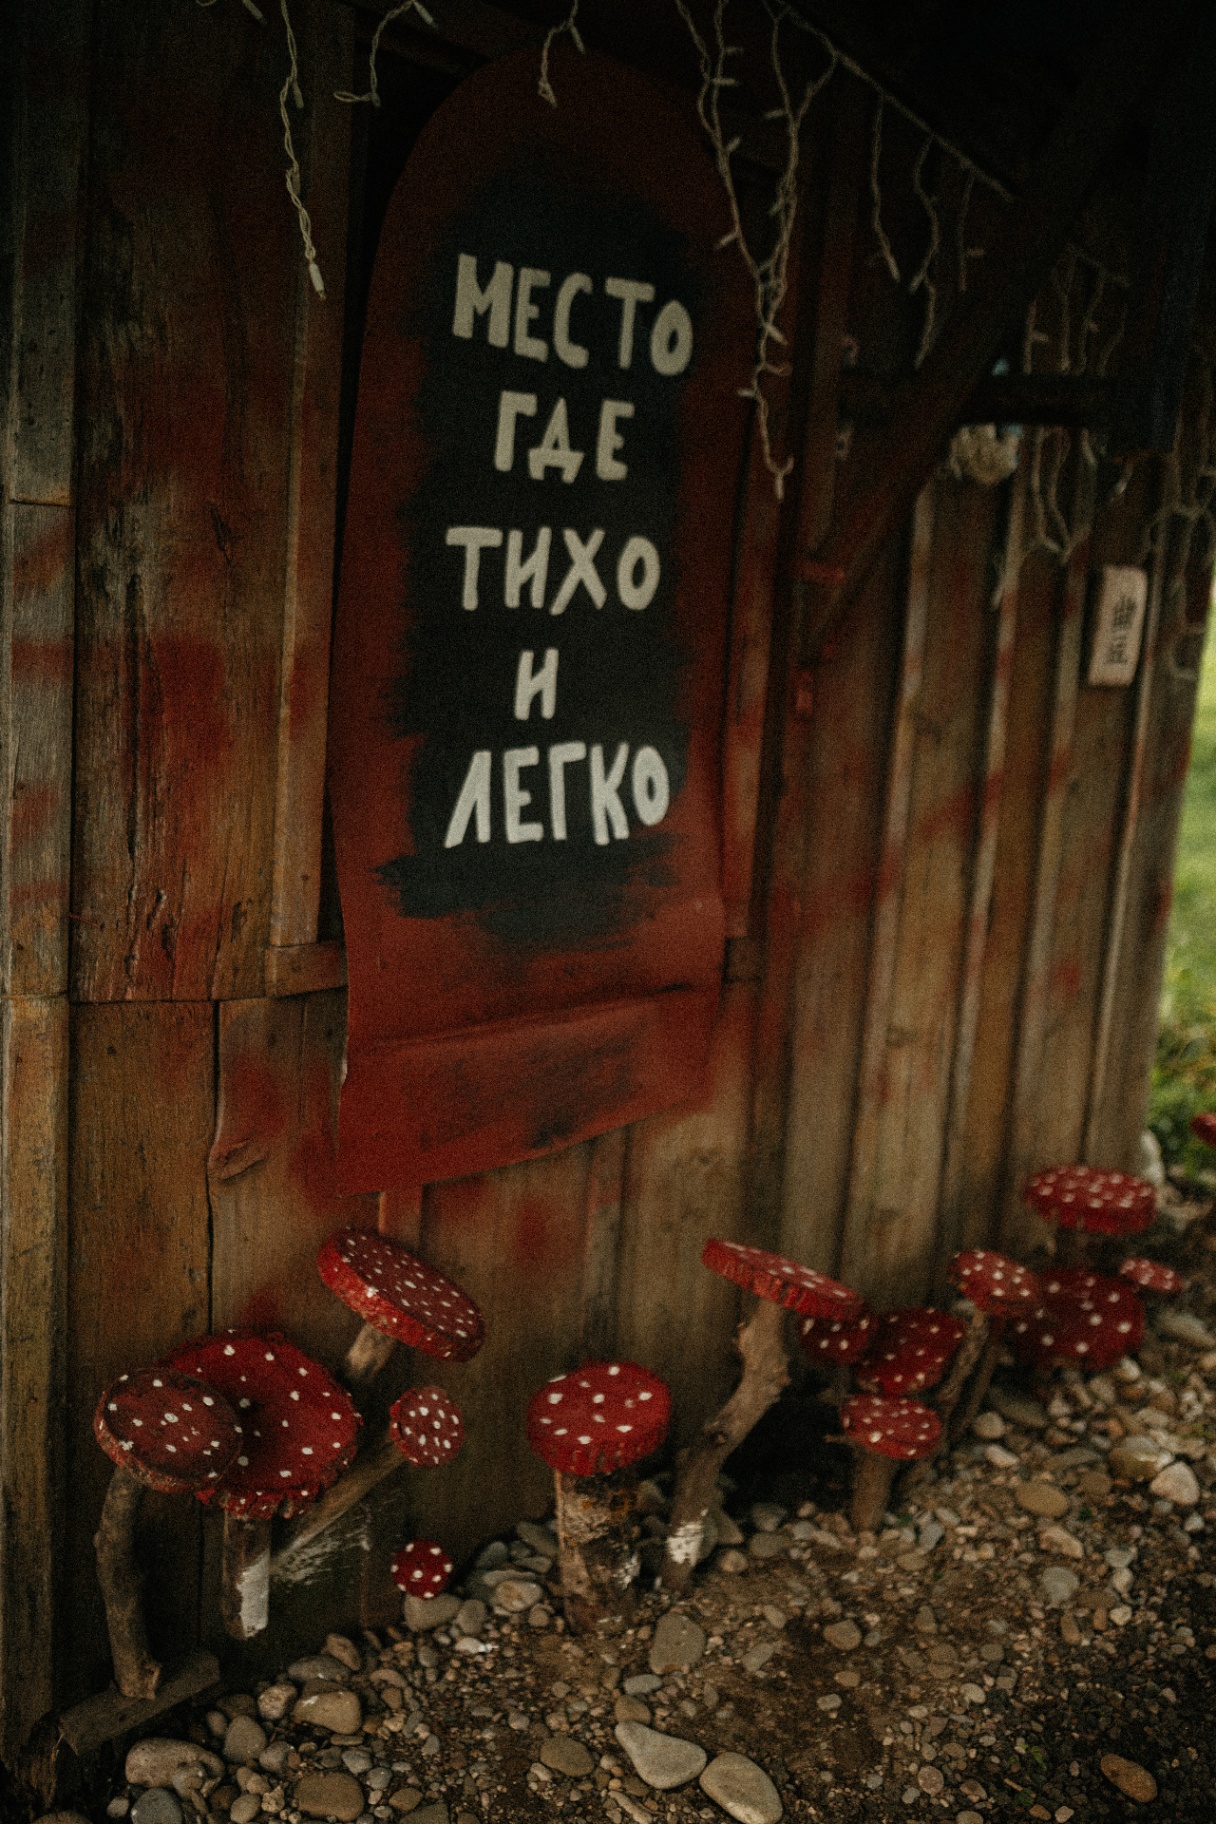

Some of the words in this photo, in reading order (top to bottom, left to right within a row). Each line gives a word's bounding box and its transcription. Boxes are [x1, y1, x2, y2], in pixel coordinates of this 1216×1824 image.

[451, 252, 693, 377] МЕСТО
[493, 389, 635, 484] ГДЕ
[444, 524, 662, 617] ТИХО
[512, 646, 560, 722] И
[442, 740, 672, 850] ЛЕГКО
